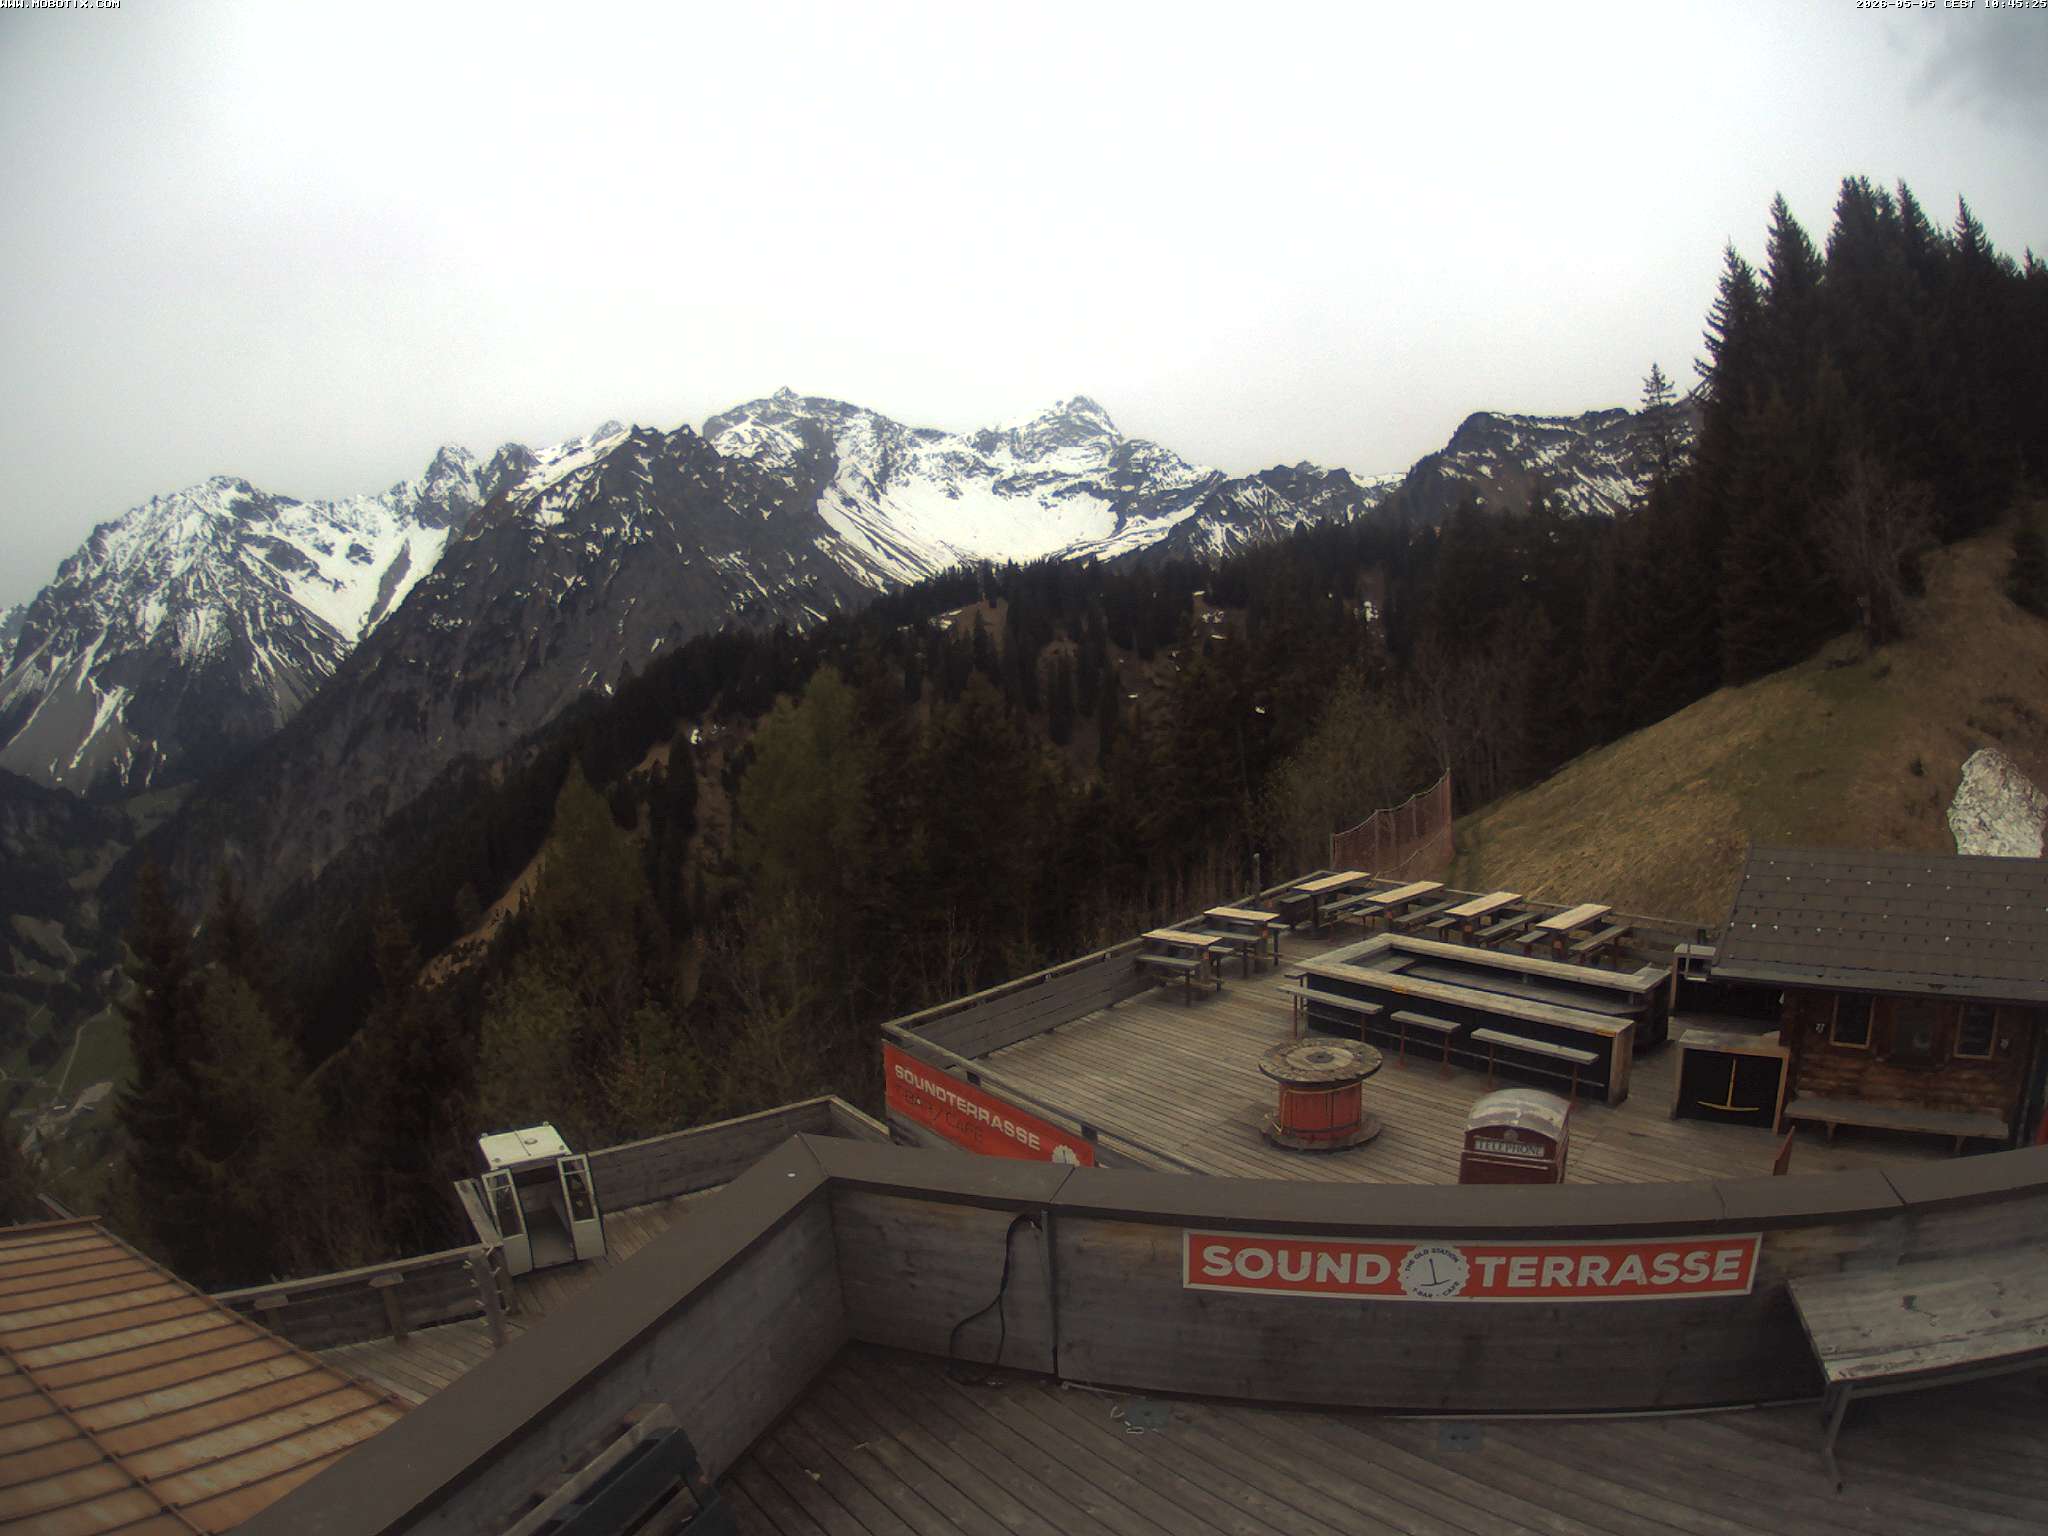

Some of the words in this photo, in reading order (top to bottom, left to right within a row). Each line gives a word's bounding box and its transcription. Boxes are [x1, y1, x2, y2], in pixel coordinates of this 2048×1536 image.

[894, 1064, 1042, 1151] SOUNDTERRASSE
[1475, 1140, 1541, 1155] TELEPHONE
[1202, 1245, 1392, 1285] SOUND
[1474, 1248, 1744, 1288] TERRASSE
